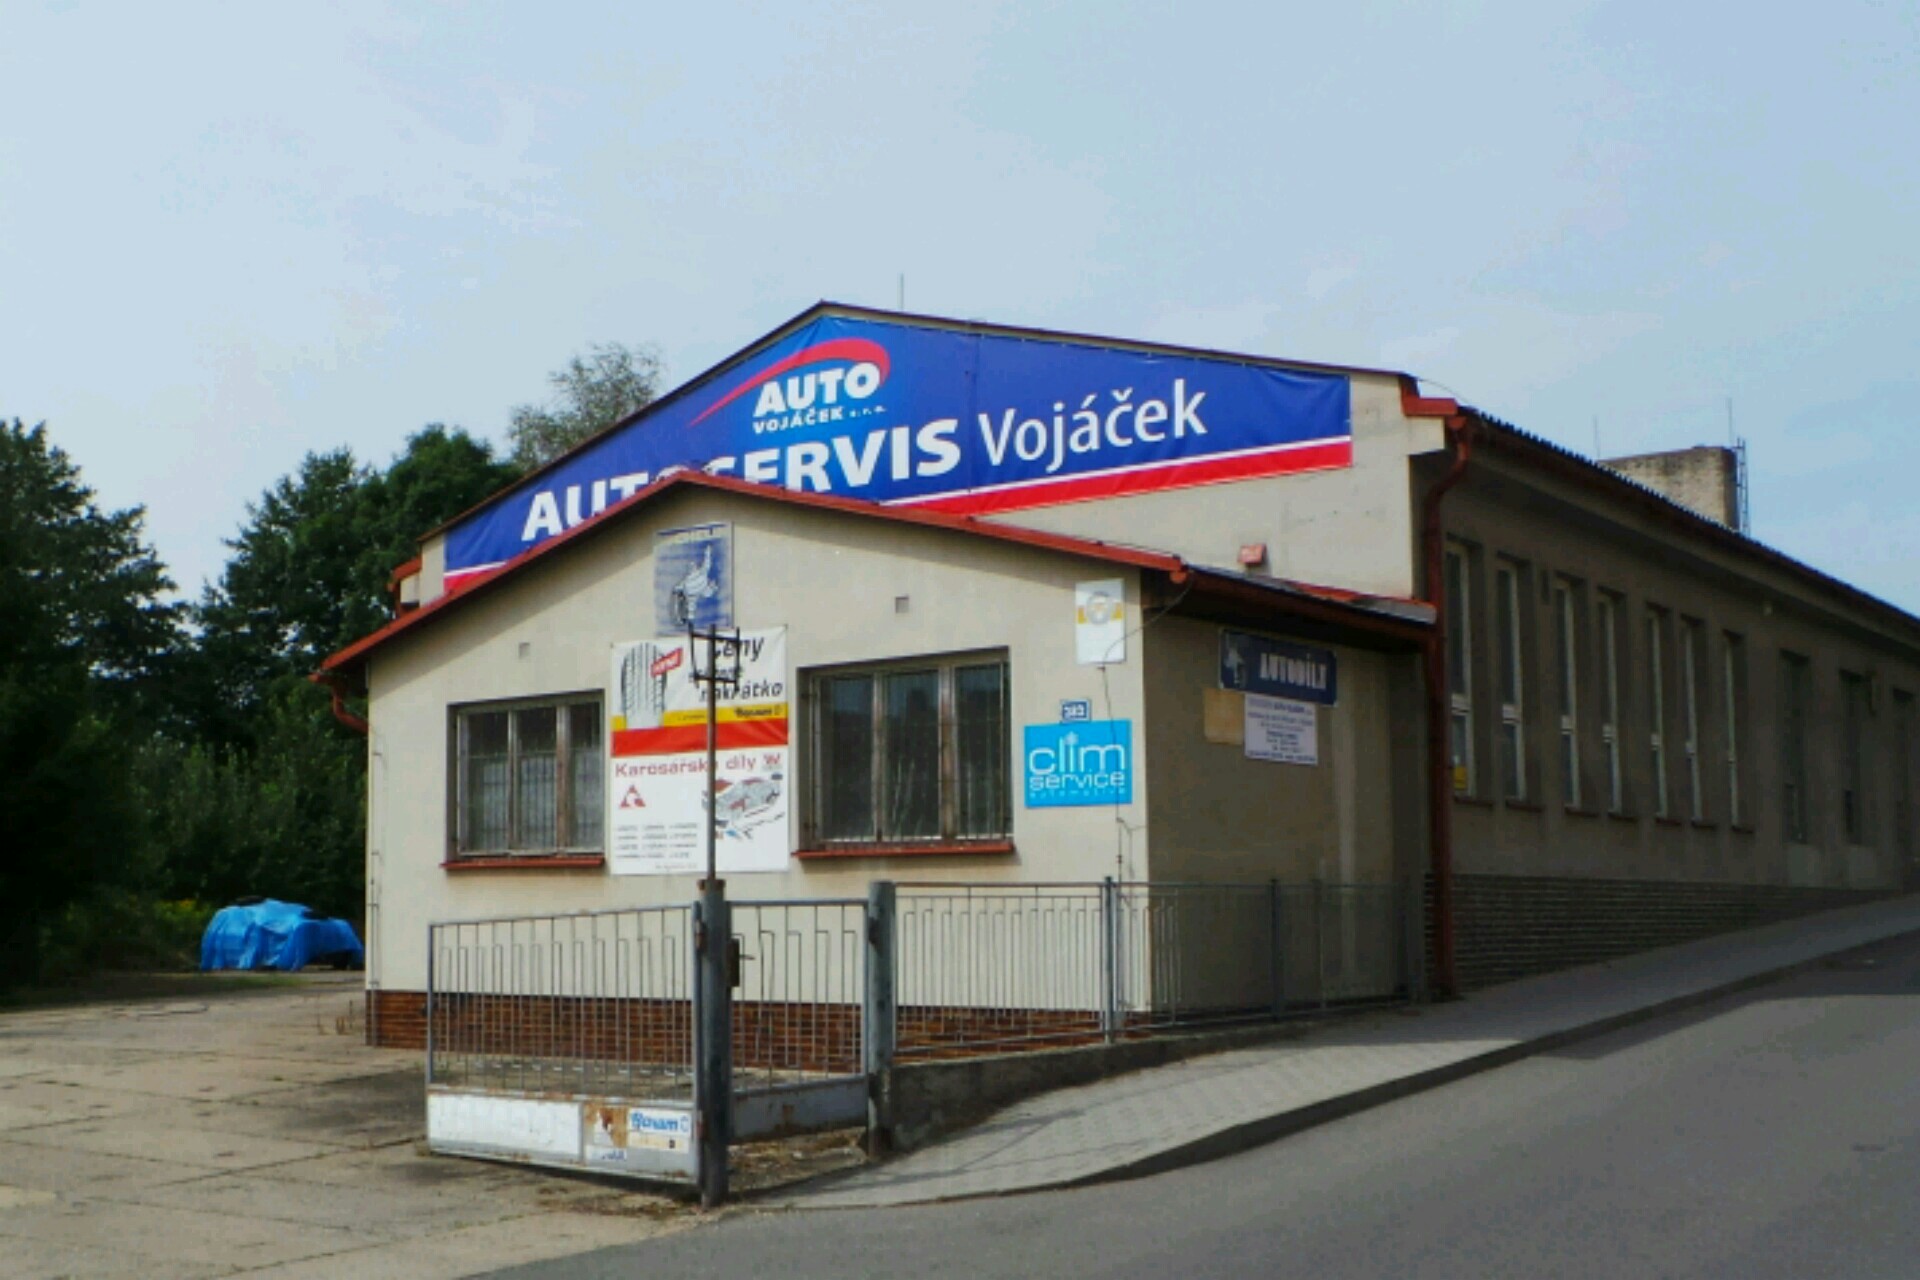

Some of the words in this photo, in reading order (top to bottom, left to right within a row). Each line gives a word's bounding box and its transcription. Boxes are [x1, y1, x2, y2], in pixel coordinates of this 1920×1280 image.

[753, 362, 881, 418] AUTO
[752, 405, 844, 434] VOJÁČEK
[520, 418, 962, 541] AUTERVIS
[978, 378, 1208, 473] Vojáček
[615, 757, 718, 777] Karosářsk
[1029, 731, 1126, 775] clim
[1029, 769, 1126, 791] service
